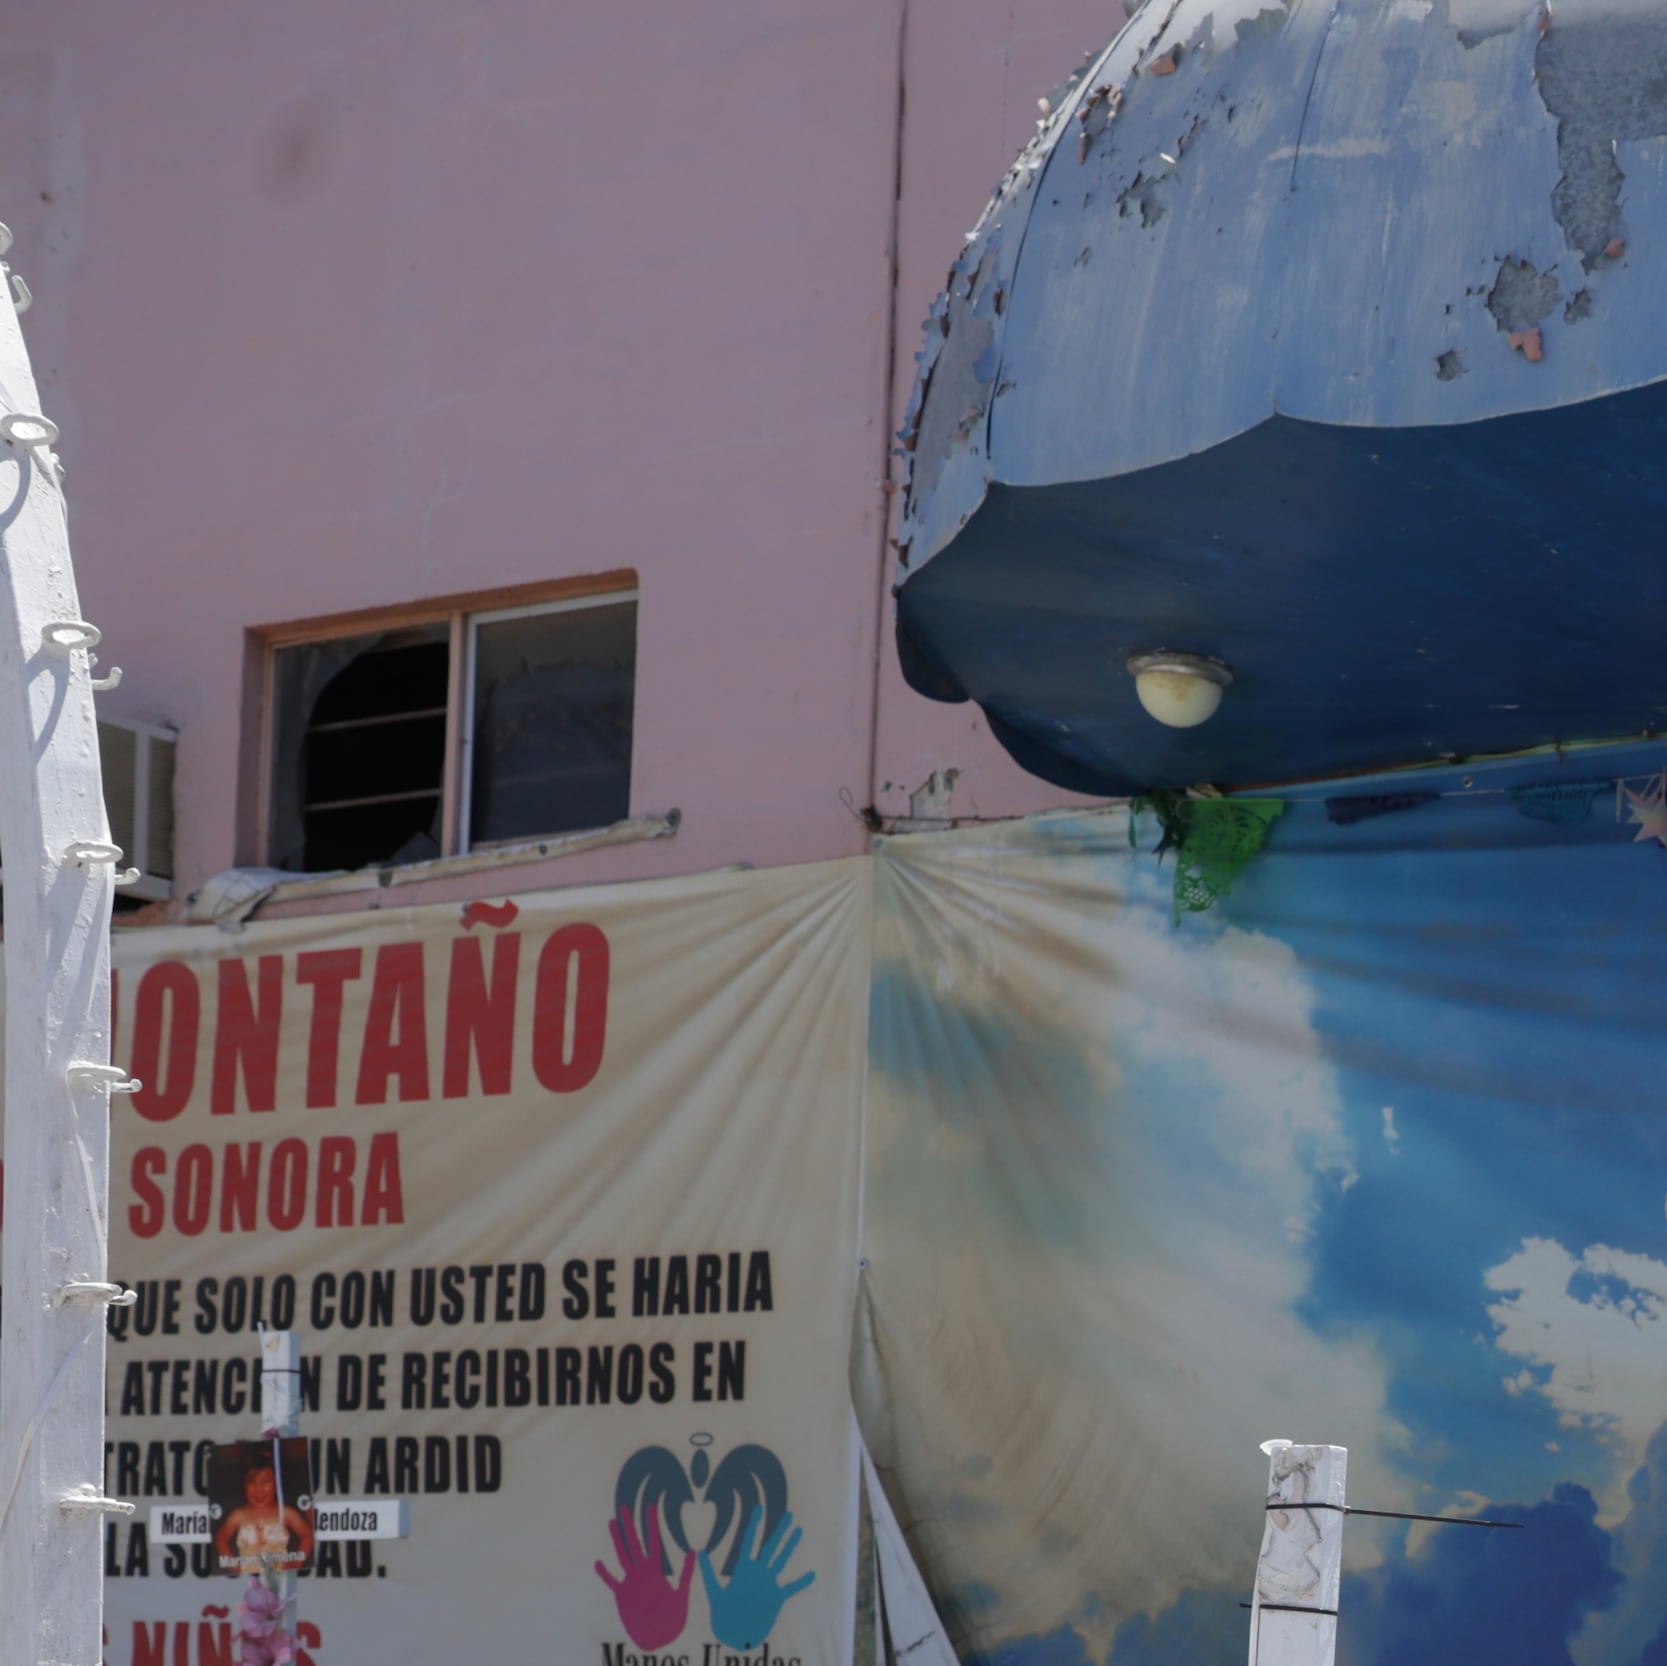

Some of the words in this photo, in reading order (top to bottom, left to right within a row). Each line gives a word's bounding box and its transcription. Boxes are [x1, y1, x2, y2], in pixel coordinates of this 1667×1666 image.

[110, 899, 610, 1123] ONTAÑO
[128, 1131, 404, 1239] SONORA
[194, 1274, 296, 1334] SOLO
[310, 1269, 394, 1331] CON
[410, 1263, 546, 1326] USTED
[562, 1258, 616, 1321] SE
[632, 1250, 774, 1317] HARIA
[121, 1355, 321, 1416] ATENCIN
[337, 1354, 386, 1413] DE
[401, 1342, 675, 1410] RECIBIRNOS
[692, 1340, 746, 1402] EN
[364, 1435, 502, 1495] ARDID
[314, 1512, 378, 1533] endoza
